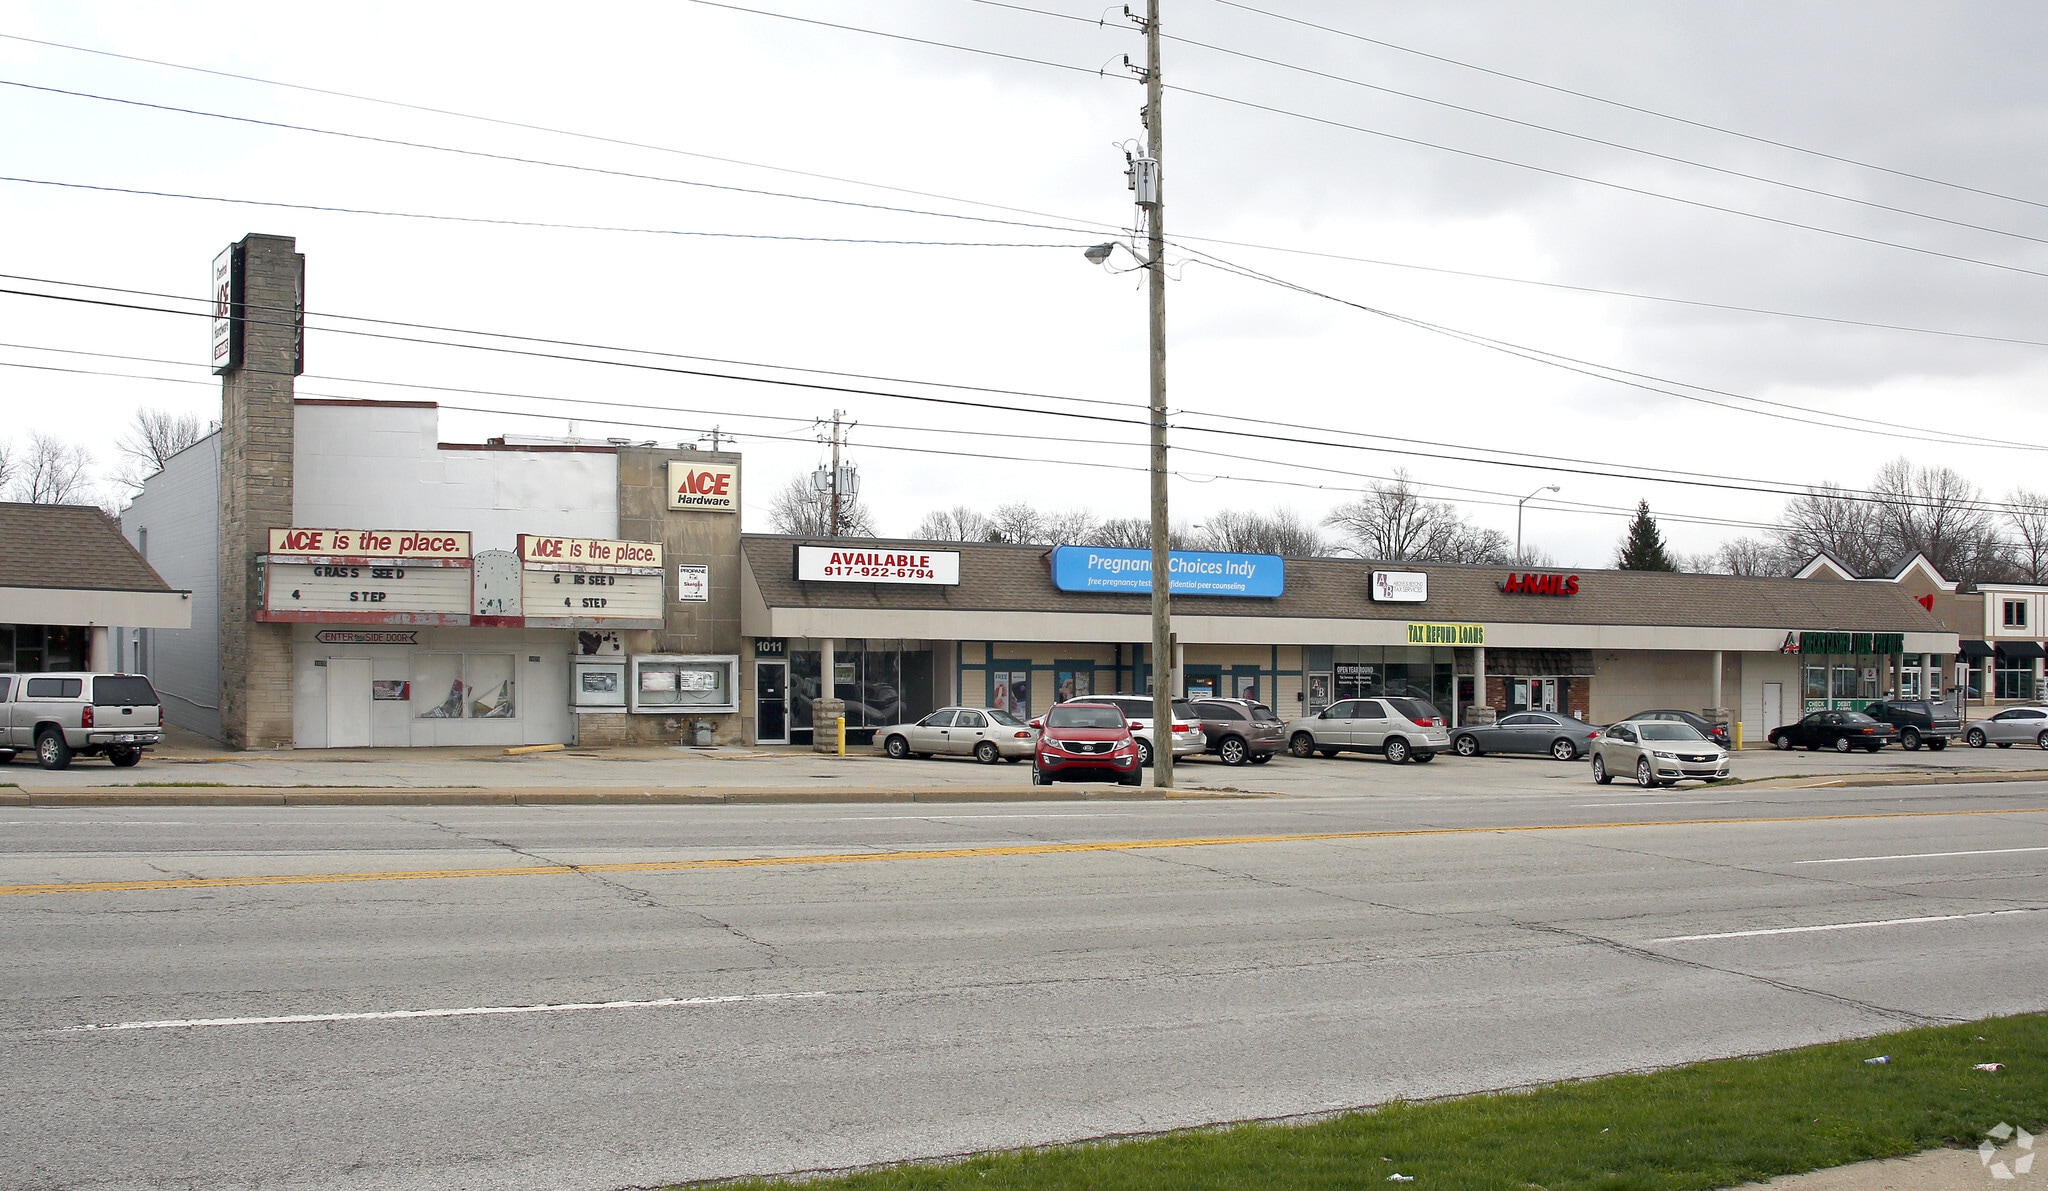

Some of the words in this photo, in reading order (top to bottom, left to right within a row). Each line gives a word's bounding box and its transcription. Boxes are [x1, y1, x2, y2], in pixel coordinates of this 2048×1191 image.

[215, 281, 229, 323] ACE
[677, 469, 731, 495] ACE
[677, 494, 730, 506] Hardware
[279, 530, 323, 550] ACE
[332, 531, 350, 549] is
[359, 531, 392, 551] the
[398, 533, 460, 554] place.
[531, 538, 563, 557] ACE
[569, 539, 582, 557] is
[588, 541, 611, 559] the
[615, 543, 656, 563] place.
[830, 552, 930, 568] AVAILABLE
[314, 566, 360, 578] GRASS
[372, 568, 405, 579] SEED
[824, 566, 934, 579] 917-922-6794
[1168, 557, 1222, 574] Choices
[1225, 560, 1256, 579] Indy
[589, 575, 615, 586] SEED
[1088, 577, 1102, 586] free
[1102, 579, 1138, 587] pregnancy
[1138, 579, 1153, 587] test
[1212, 581, 1246, 591] counseling
[1377, 573, 1387, 586] A
[1503, 572, 1580, 596] A-NAILS
[292, 589, 301, 600] 4
[350, 591, 386, 602] STEP
[1384, 585, 1393, 598] B
[564, 597, 571, 608] 4
[582, 597, 607, 608] STEP
[325, 633, 353, 641] ENTER
[366, 633, 384, 642] SIDE
[386, 633, 408, 642] DOOR
[1408, 624, 1424, 642] TAX
[1426, 624, 1457, 643] REFUND
[1459, 625, 1483, 644] LOANS
[756, 641, 782, 652] 1011
